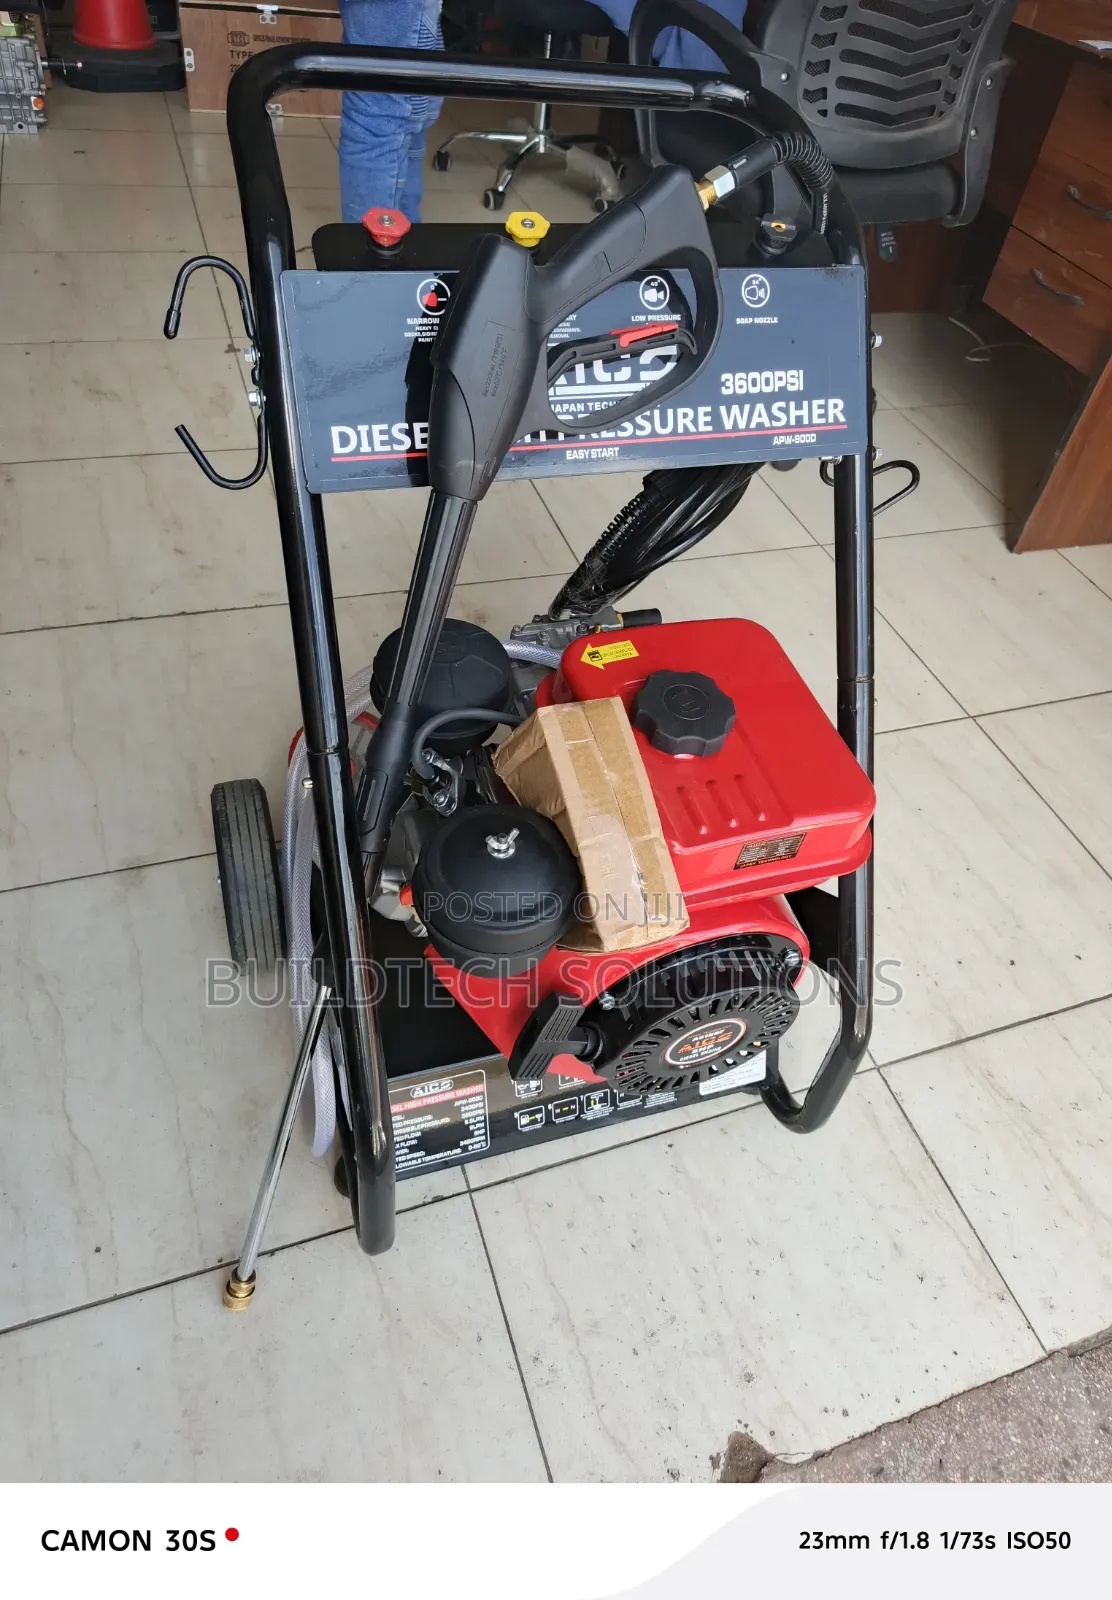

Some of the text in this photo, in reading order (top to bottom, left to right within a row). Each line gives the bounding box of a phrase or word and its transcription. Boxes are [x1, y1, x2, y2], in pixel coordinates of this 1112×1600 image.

[406, 317, 440, 325] NARROW
[647, 314, 682, 322] PRESSURE
[736, 316, 778, 325] SOAP NOZZLE
[720, 369, 804, 395] 3600PSI
[330, 422, 429, 455] DIESE
[719, 398, 847, 430] WASHER
[404, 1099, 422, 1110] HIGH
[423, 1092, 455, 1106] PRESSURE
[456, 1085, 484, 1098] WASHER
[392, 1120, 403, 1128] TED
[394, 1134, 404, 1142] TED
[404, 1131, 422, 1141] FLOW:
[401, 1139, 418, 1148] FLOW:
[395, 1154, 405, 1163] TED
[405, 1151, 426, 1161] SPEED:
[395, 1158, 422, 1169] LOWABLE
[421, 1148, 462, 1163] TEMPERATURE:
